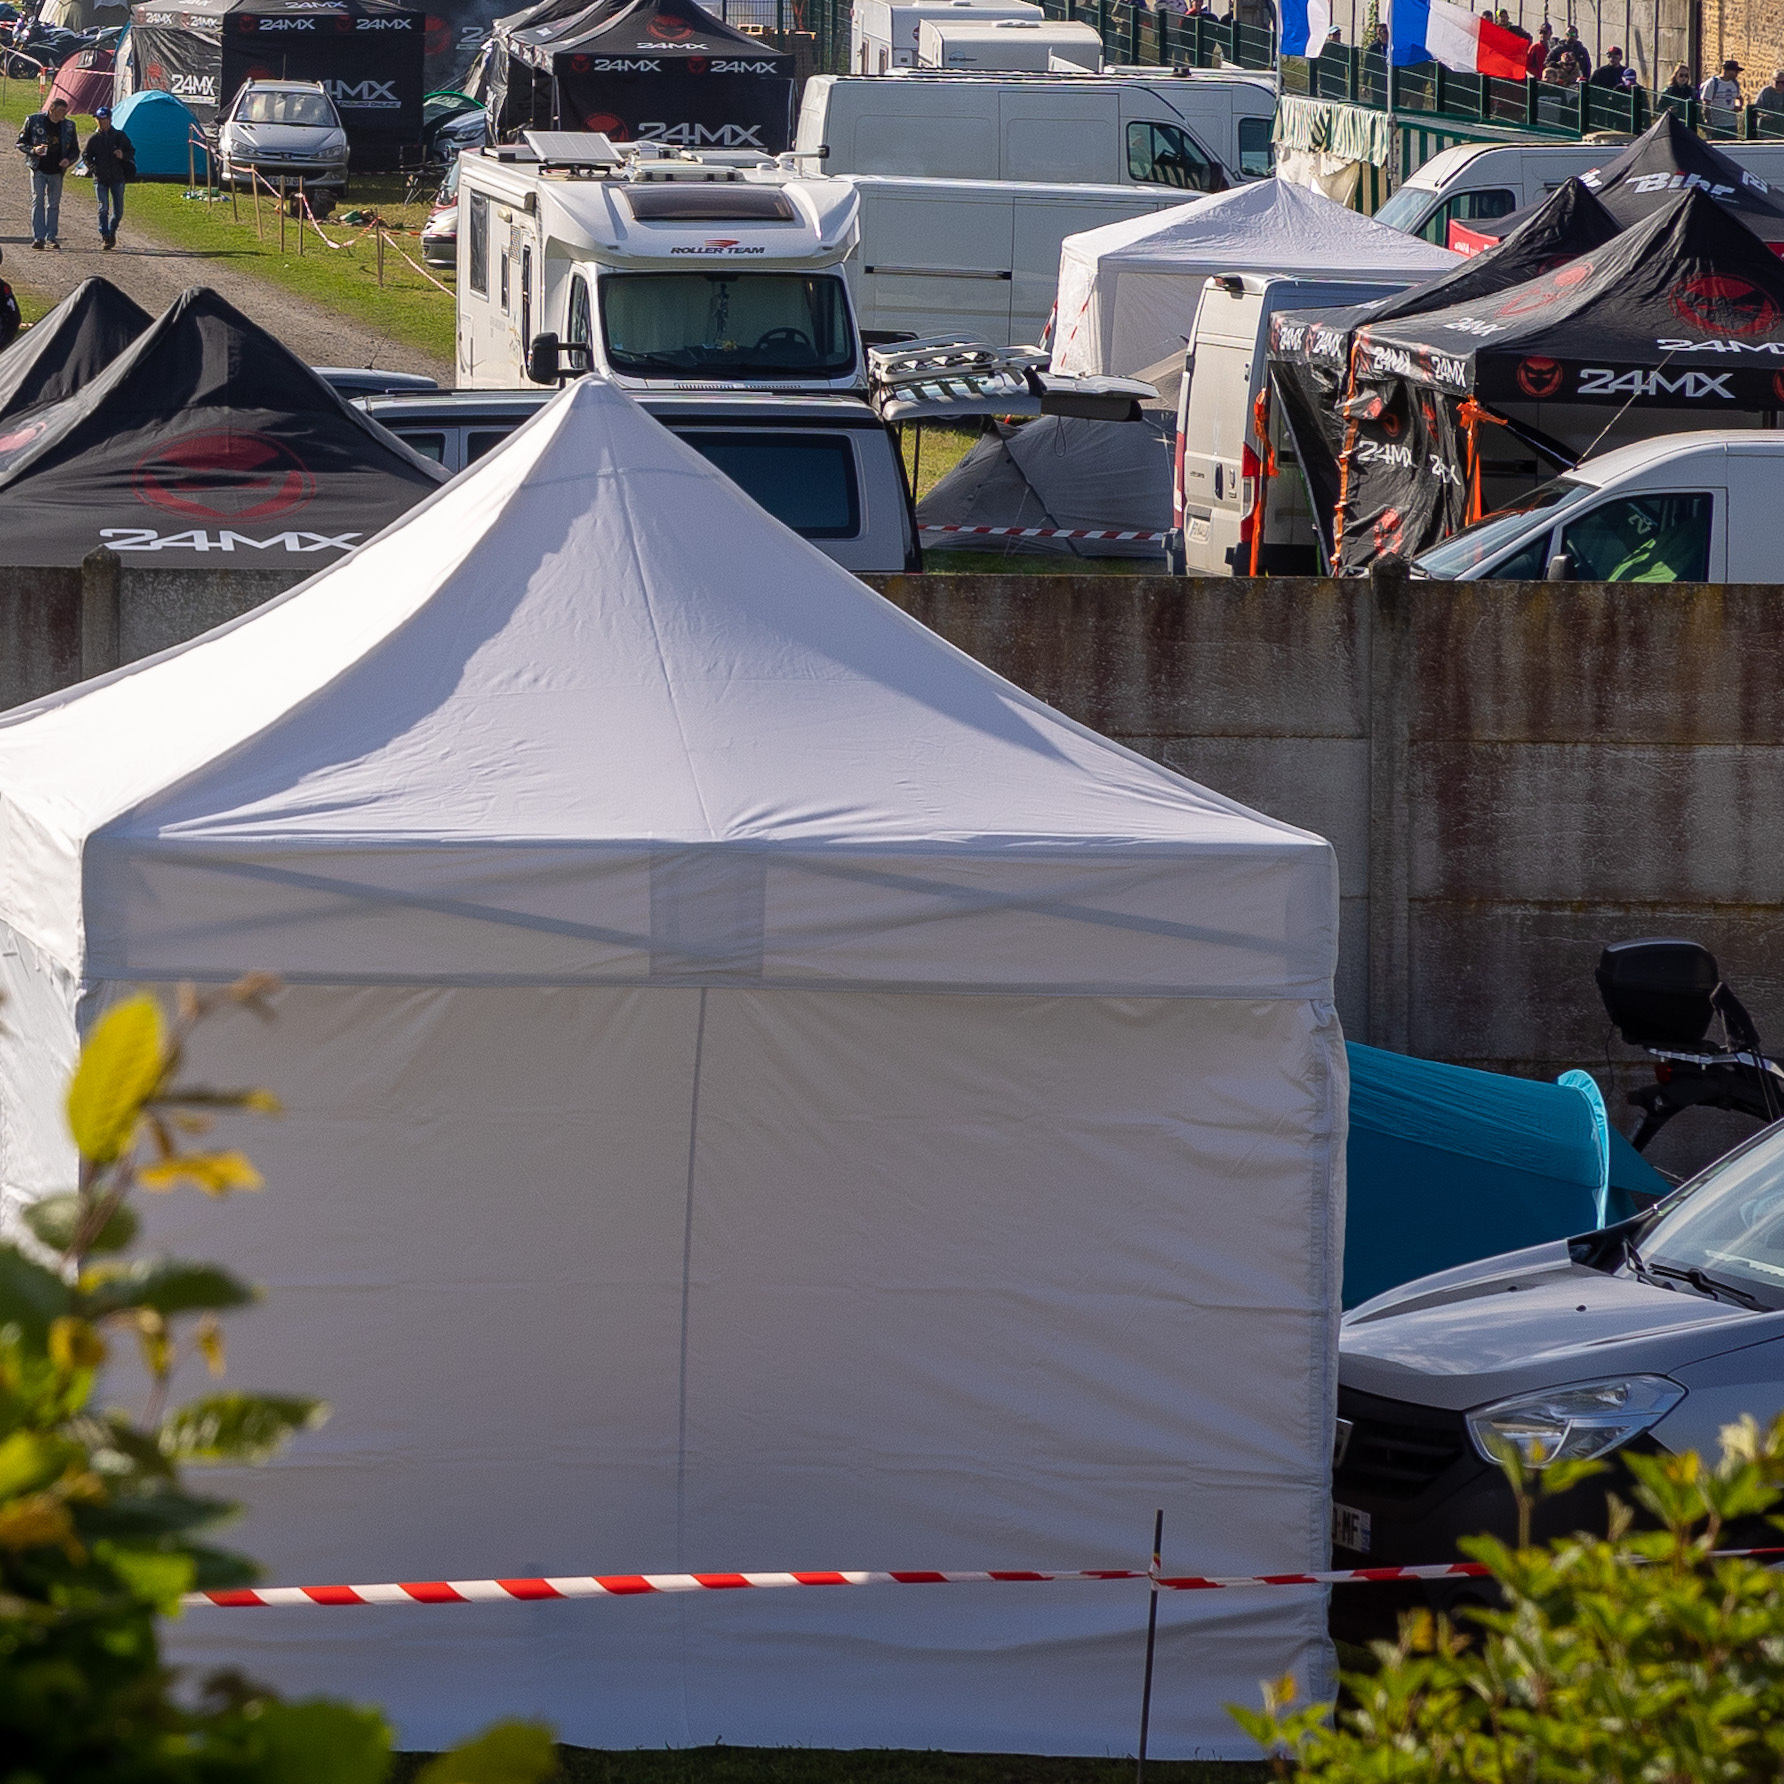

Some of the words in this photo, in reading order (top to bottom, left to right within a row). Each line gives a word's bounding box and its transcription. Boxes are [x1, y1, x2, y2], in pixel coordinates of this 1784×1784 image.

[285, 1, 349, 10] 24MX
[145, 12, 173, 25] 24MX
[190, 16, 219, 29] 24MX
[259, 17, 316, 31] 24MX
[355, 18, 413, 31] 24MX
[635, 41, 710, 51] 24MX
[593, 58, 663, 73] 24MX
[710, 60, 778, 75] 24MX
[170, 73, 216, 97] 24MX
[637, 121, 765, 147] 24MX
[1625, 171, 1738, 197] Bihr
[670, 246, 725, 255] ROLLER
[727, 246, 766, 255] TEAM
[1279, 326, 1305, 351] 24MX
[1312, 330, 1345, 358] 24MX
[1373, 346, 1412, 374] 24MX
[1430, 355, 1467, 389] 24MX
[1577, 368, 1736, 399] 24MX
[99, 527, 365, 552] 24MX
